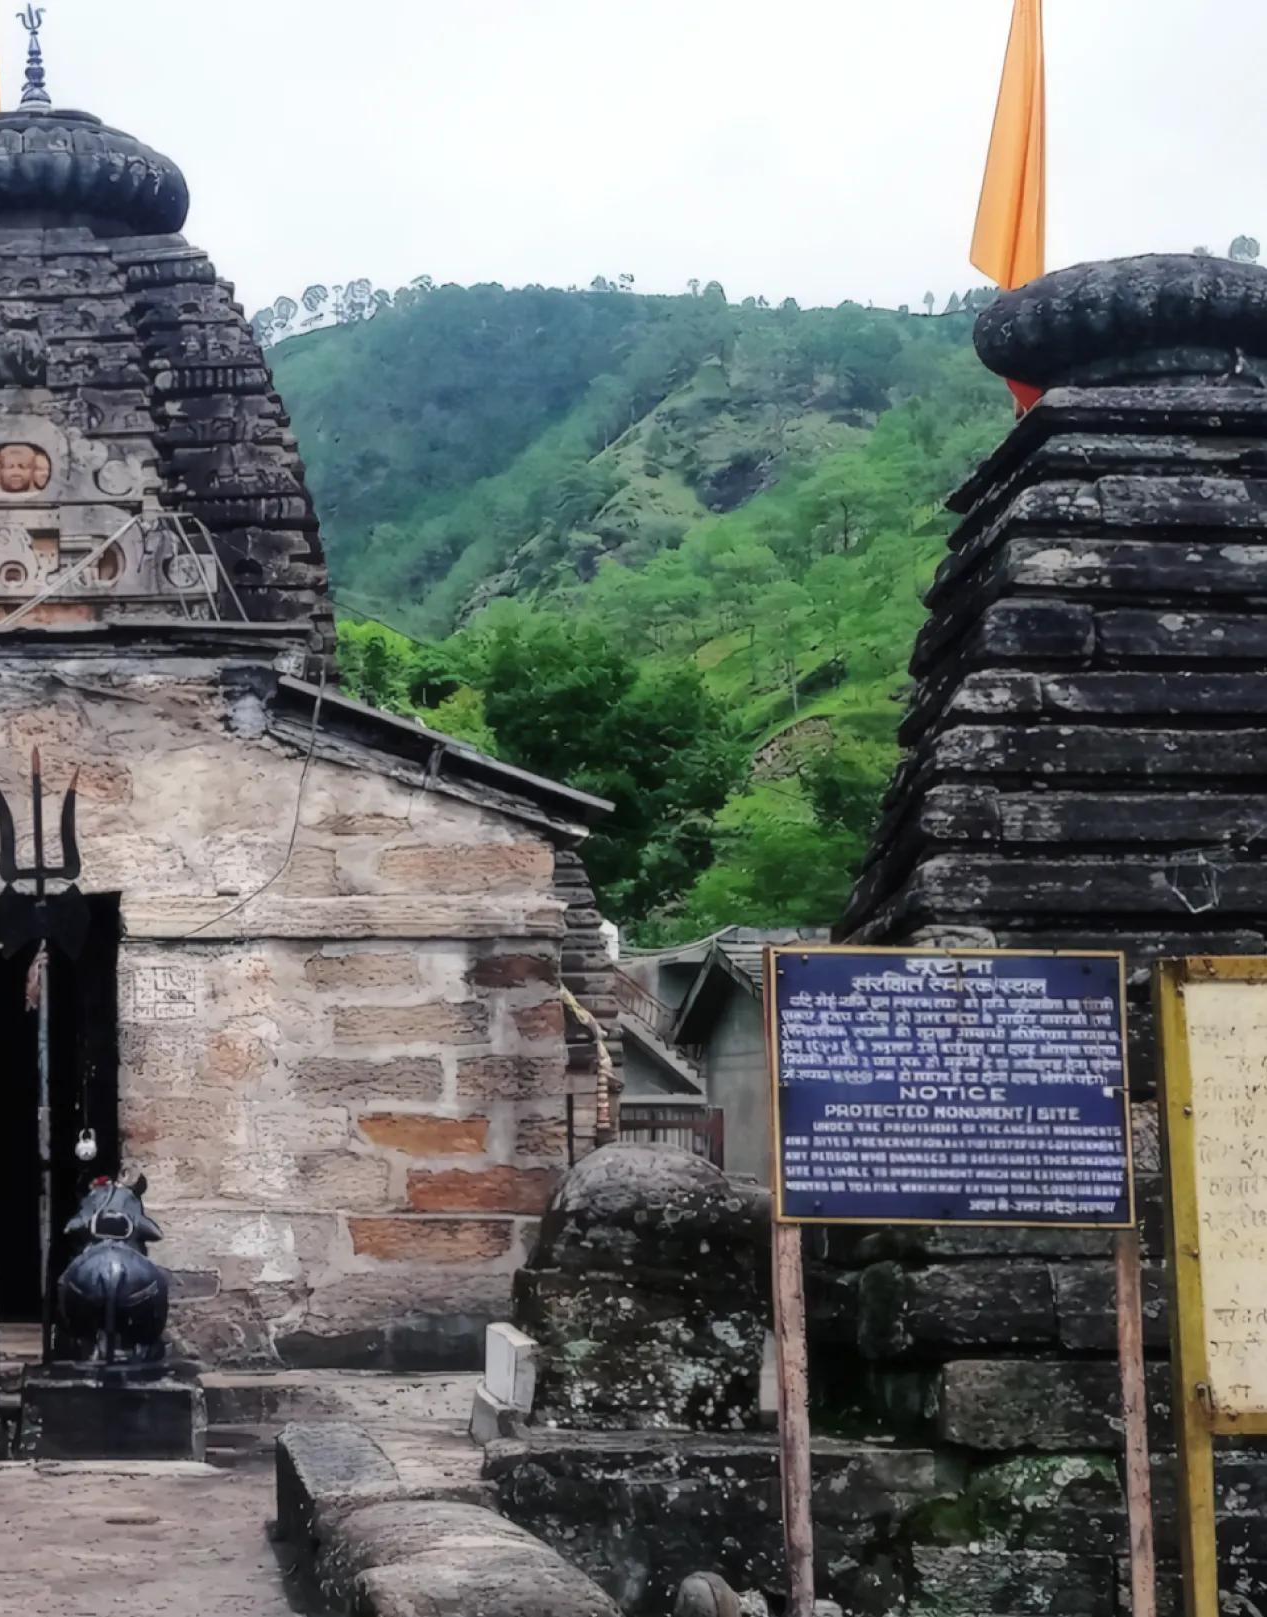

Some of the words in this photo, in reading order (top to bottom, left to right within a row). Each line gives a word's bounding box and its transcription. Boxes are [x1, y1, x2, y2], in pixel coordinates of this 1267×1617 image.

[851, 970, 924, 993] संरक्षित
[899, 1085, 1007, 1102] NOTICE
[824, 1103, 929, 1119] PROTECTED
[812, 1121, 854, 1132] UNDER
[857, 1122, 882, 1132] THE
[1052, 1125, 1123, 1137] MONUMENTS
[785, 1151, 809, 1161] ANY
[811, 1151, 859, 1162] PERSON
[861, 1151, 887, 1163] WHO
[785, 1165, 810, 1177] SITE
[827, 1166, 870, 1178] LIABLE
[872, 1167, 888, 1178] TO
[975, 1169, 1009, 1180] WHICH
[785, 1180, 830, 1192] MONTHS
